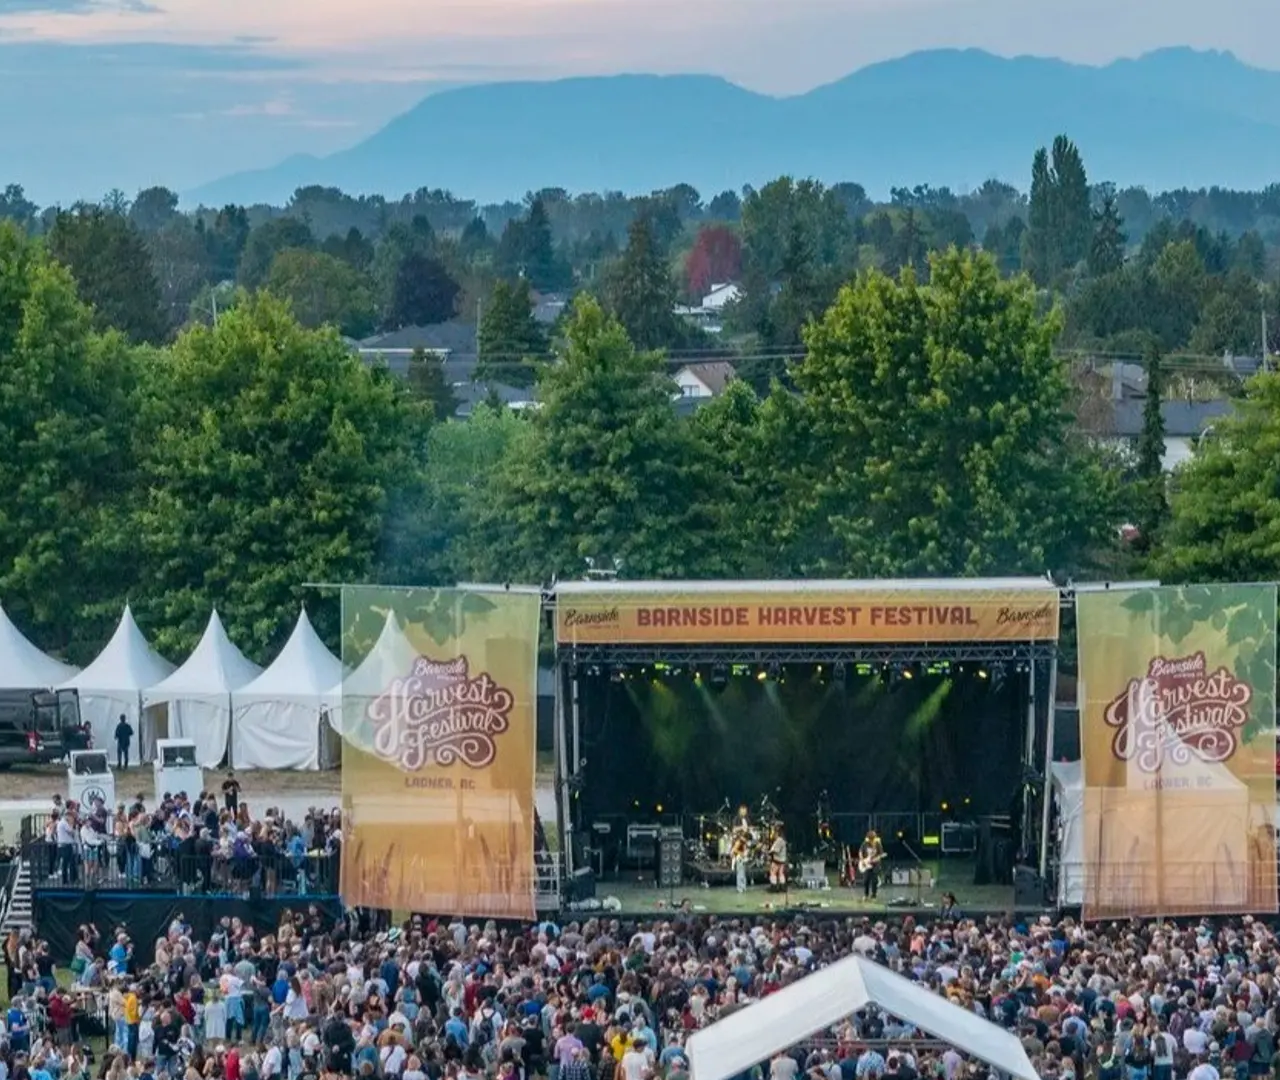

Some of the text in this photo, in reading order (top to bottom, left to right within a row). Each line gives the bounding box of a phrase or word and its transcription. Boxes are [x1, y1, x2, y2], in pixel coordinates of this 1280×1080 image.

[637, 606, 978, 626] BARNSIDE HARVEST FESTIVAL
[368, 675, 506, 755] Harvest
[400, 705, 505, 770] Festival
[1106, 669, 1244, 759] Harvest
